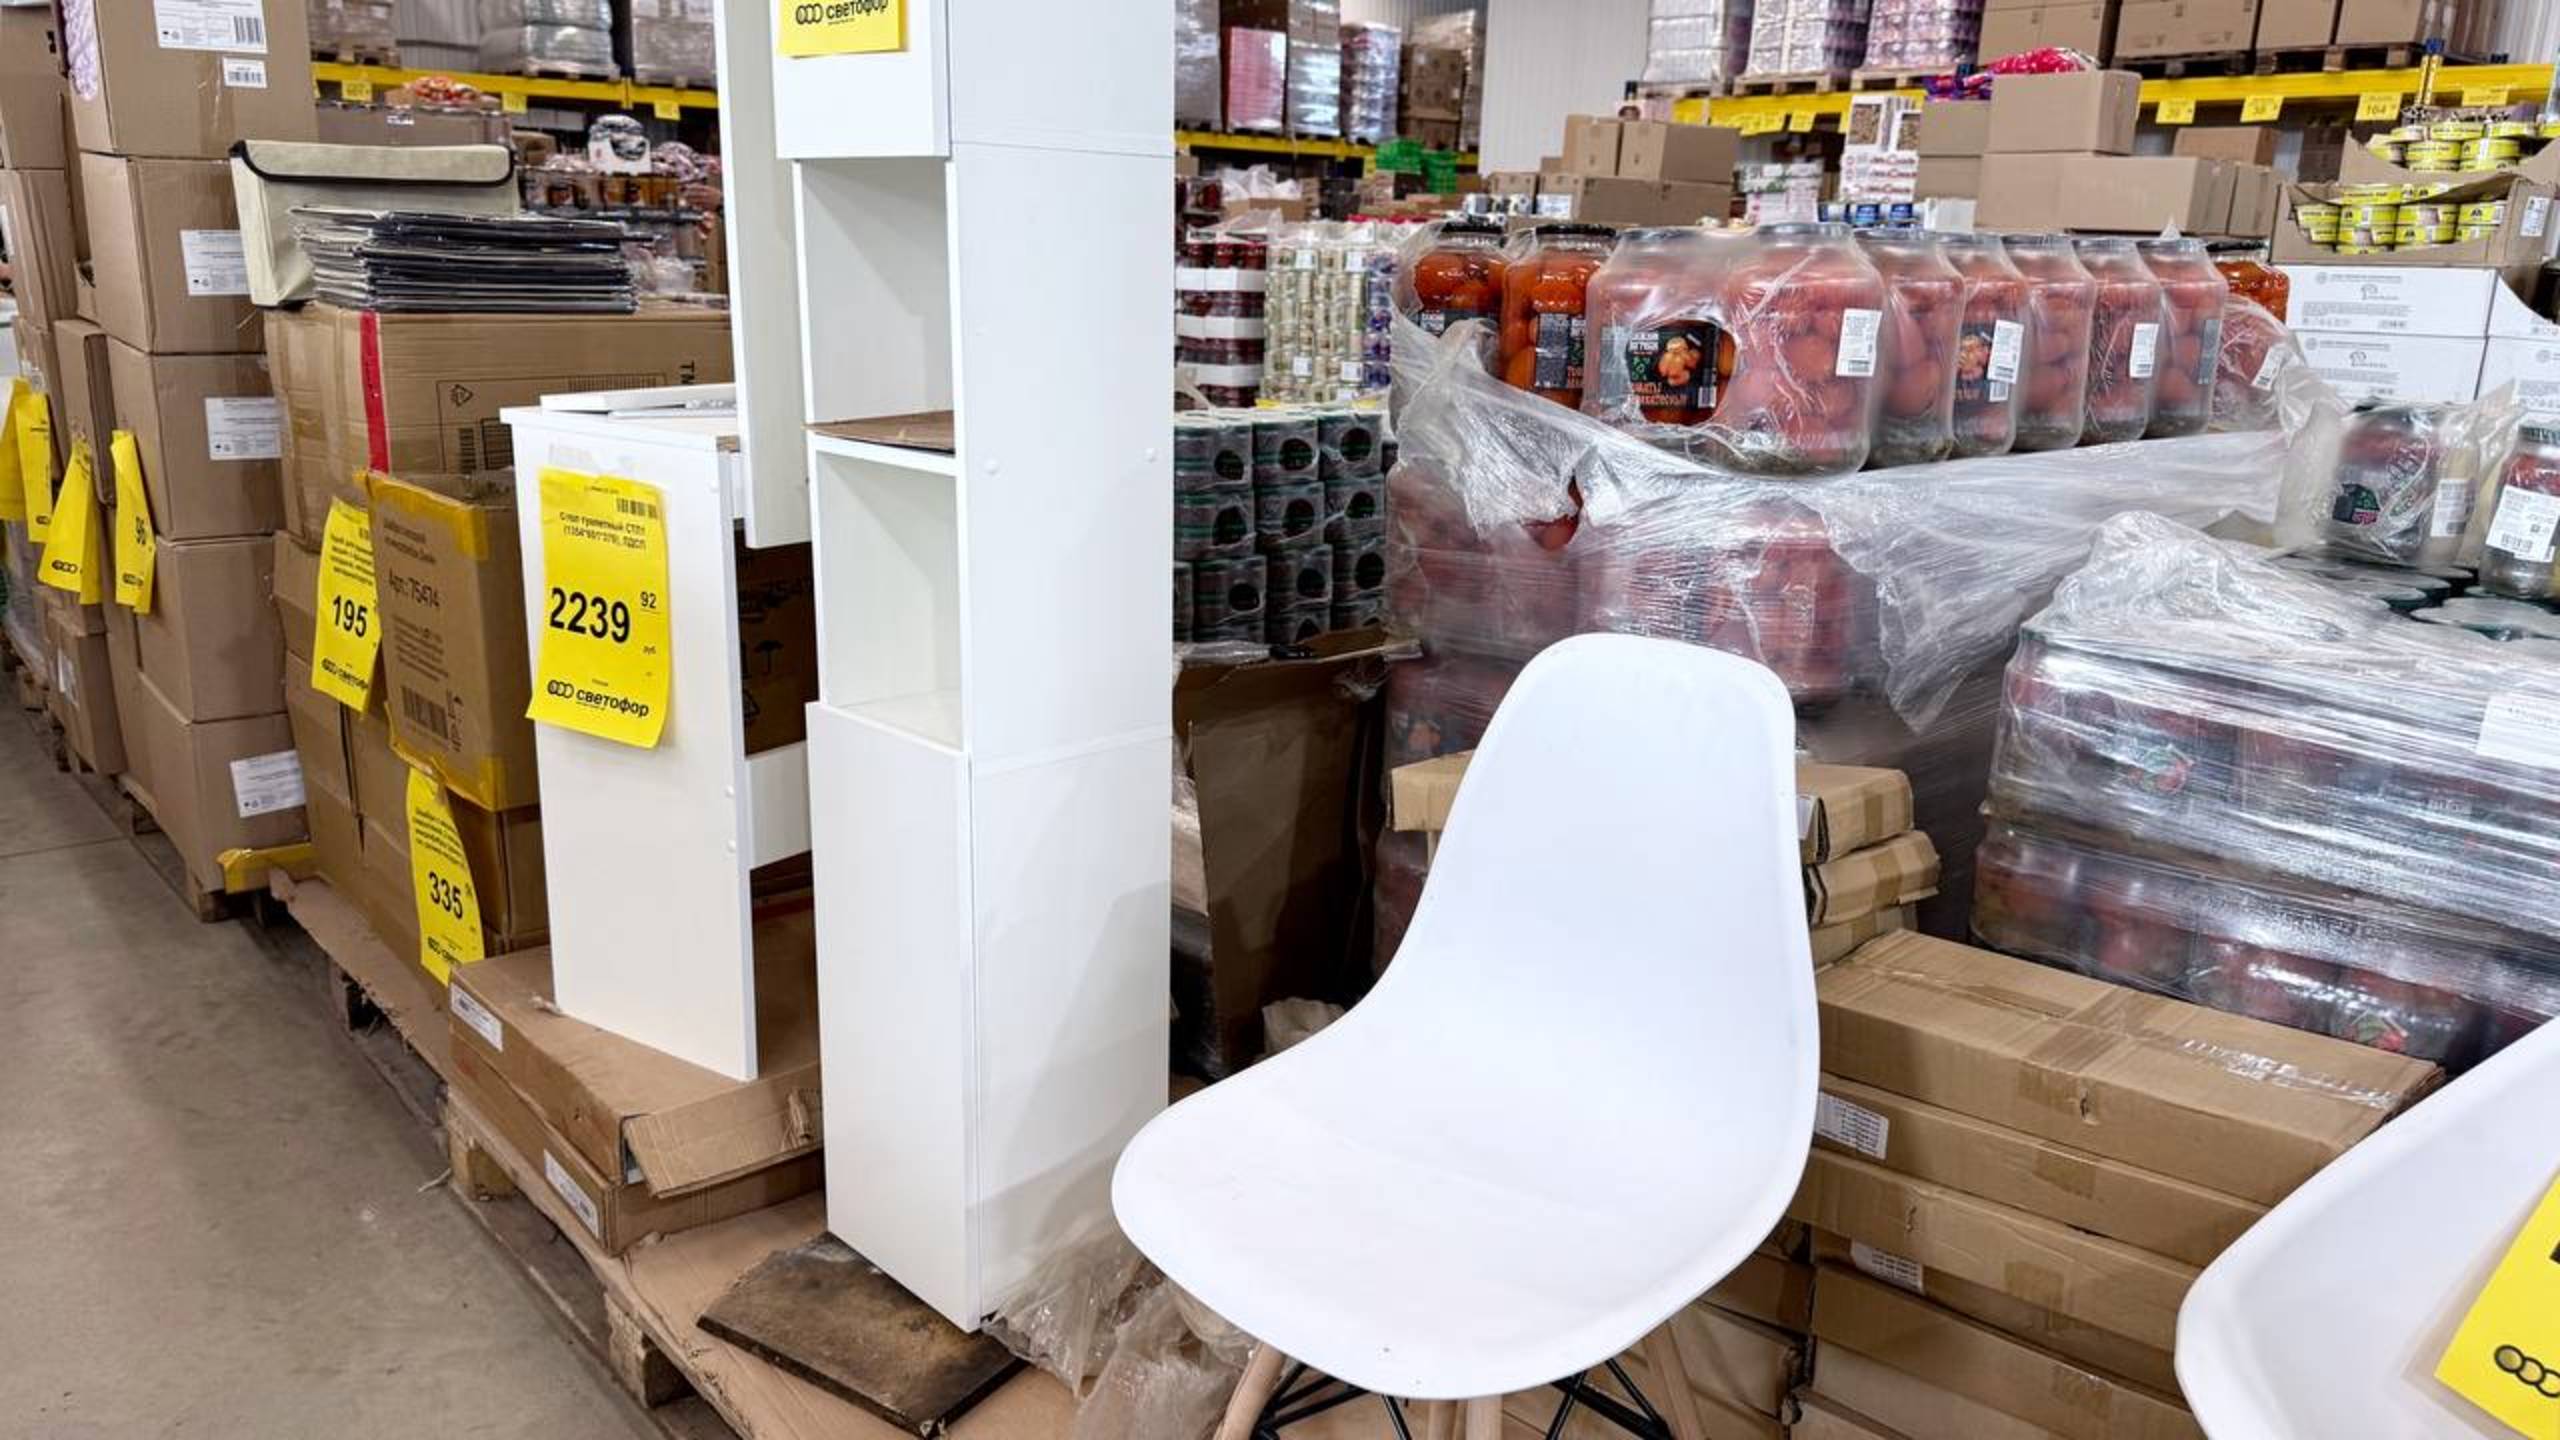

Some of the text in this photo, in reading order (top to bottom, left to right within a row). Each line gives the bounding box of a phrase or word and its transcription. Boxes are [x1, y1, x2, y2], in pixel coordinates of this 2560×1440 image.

[333, 595, 367, 637] 195
[550, 586, 630, 644] 2239
[639, 591, 657, 609] 92
[575, 689, 650, 717] светофор
[429, 870, 463, 919] 335
